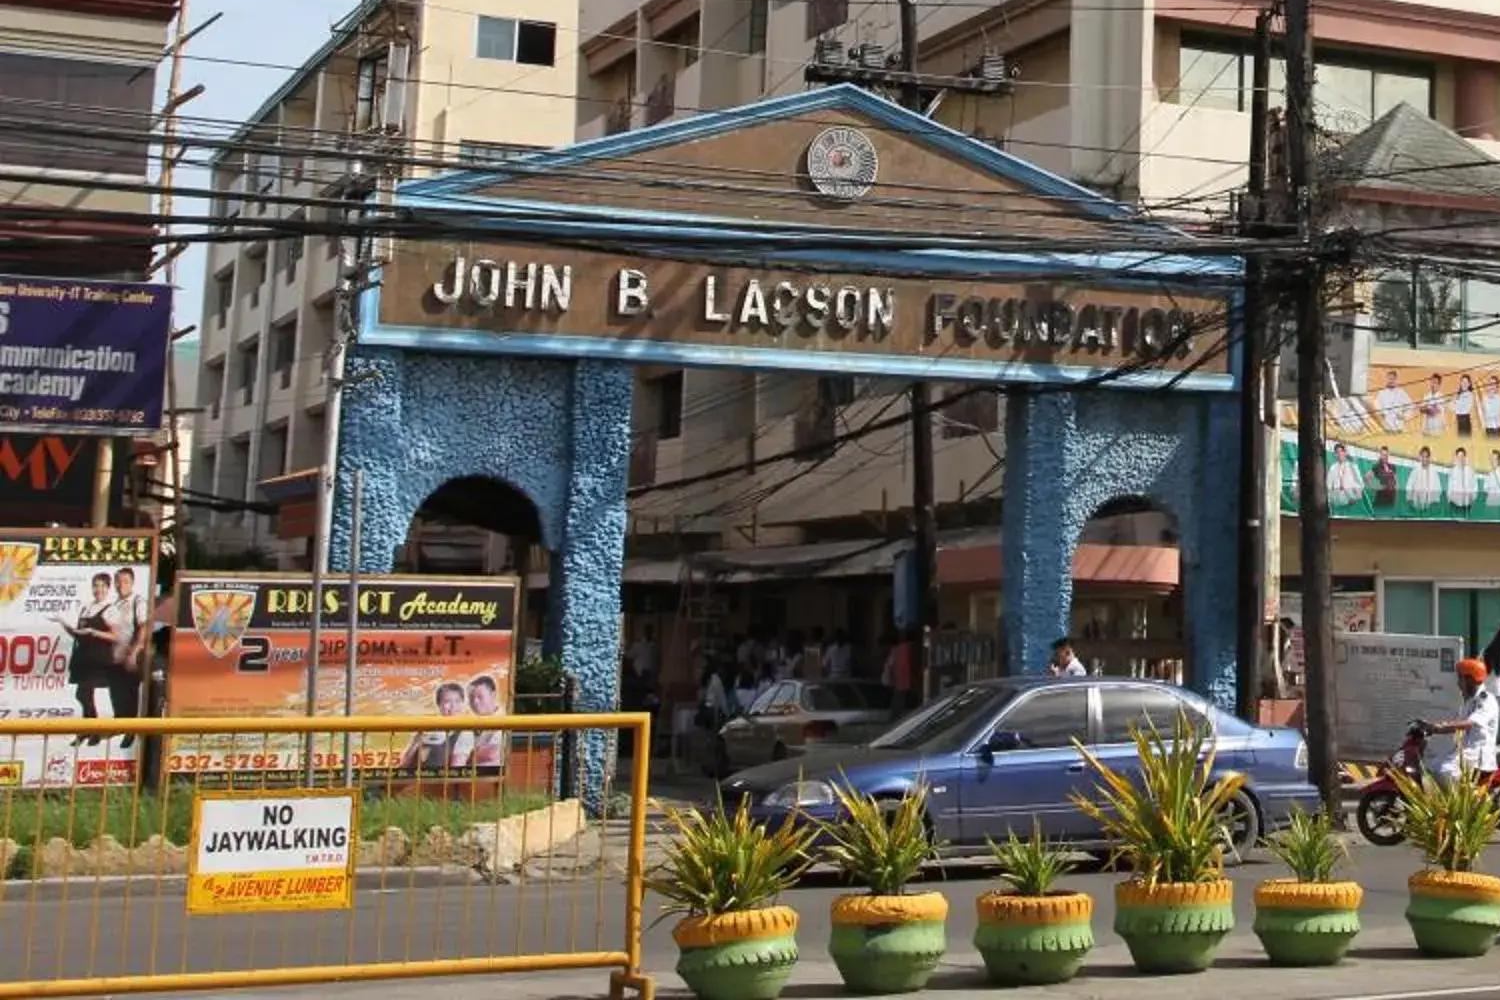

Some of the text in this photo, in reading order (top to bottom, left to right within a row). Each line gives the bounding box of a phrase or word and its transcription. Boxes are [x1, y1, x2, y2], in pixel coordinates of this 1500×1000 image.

[433, 257, 572, 312] JOHN
[705, 274, 895, 333] LACSON
[28, 584, 78, 597] WORKING
[267, 588, 498, 625] RRS-CT Academy
[239, 638, 271, 671] 2
[317, 638, 400, 656] DIPOMA
[167, 753, 279, 771] 337-5792
[263, 805, 293, 827] NO
[205, 826, 346, 853] JAYWALKING
[226, 875, 346, 897] AVENUE LUMBER
